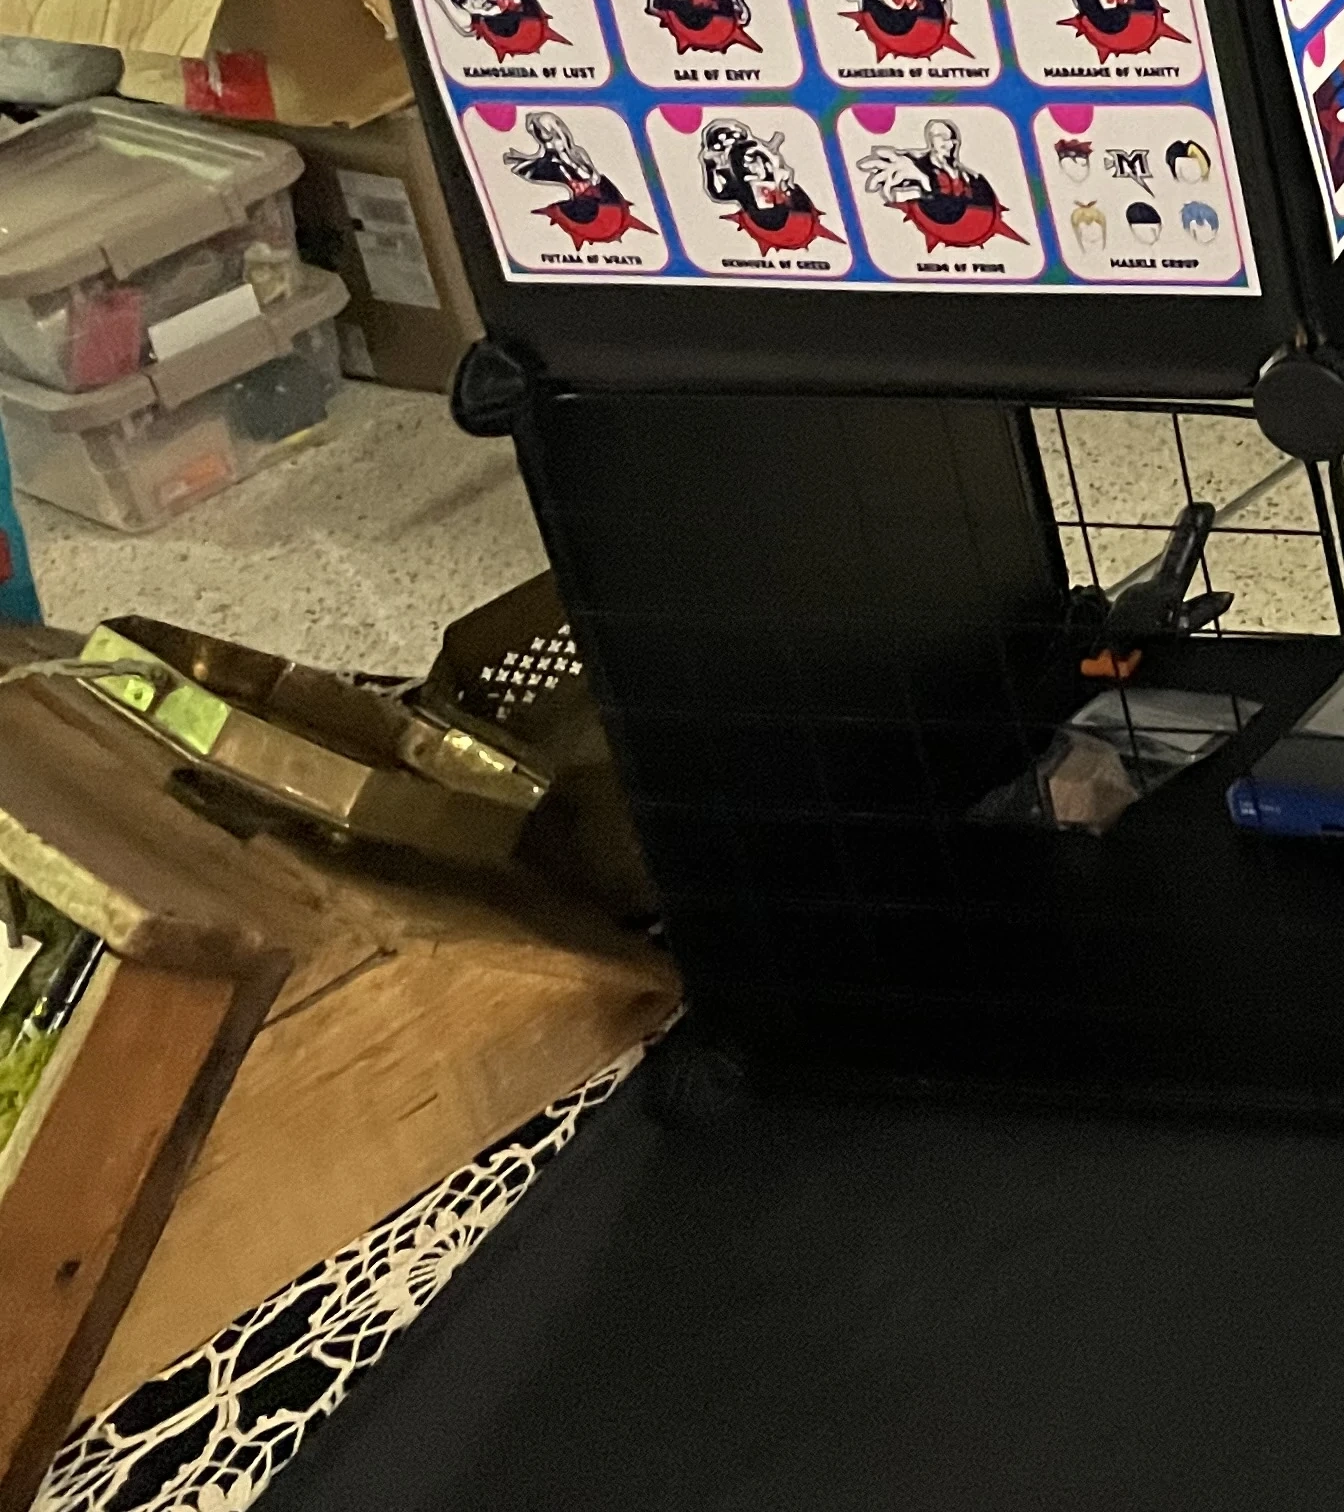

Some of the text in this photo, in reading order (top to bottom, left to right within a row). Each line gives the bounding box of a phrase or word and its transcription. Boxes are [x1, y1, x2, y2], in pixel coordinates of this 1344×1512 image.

[543, 67, 557, 78] OF
[563, 67, 595, 79] LUST
[704, 69, 719, 80] OF
[726, 69, 760, 81] ENVY
[910, 68, 922, 78] OF
[1116, 67, 1129, 78] OF
[1135, 66, 1179, 78] VANITY
[587, 254, 599, 264] OF
